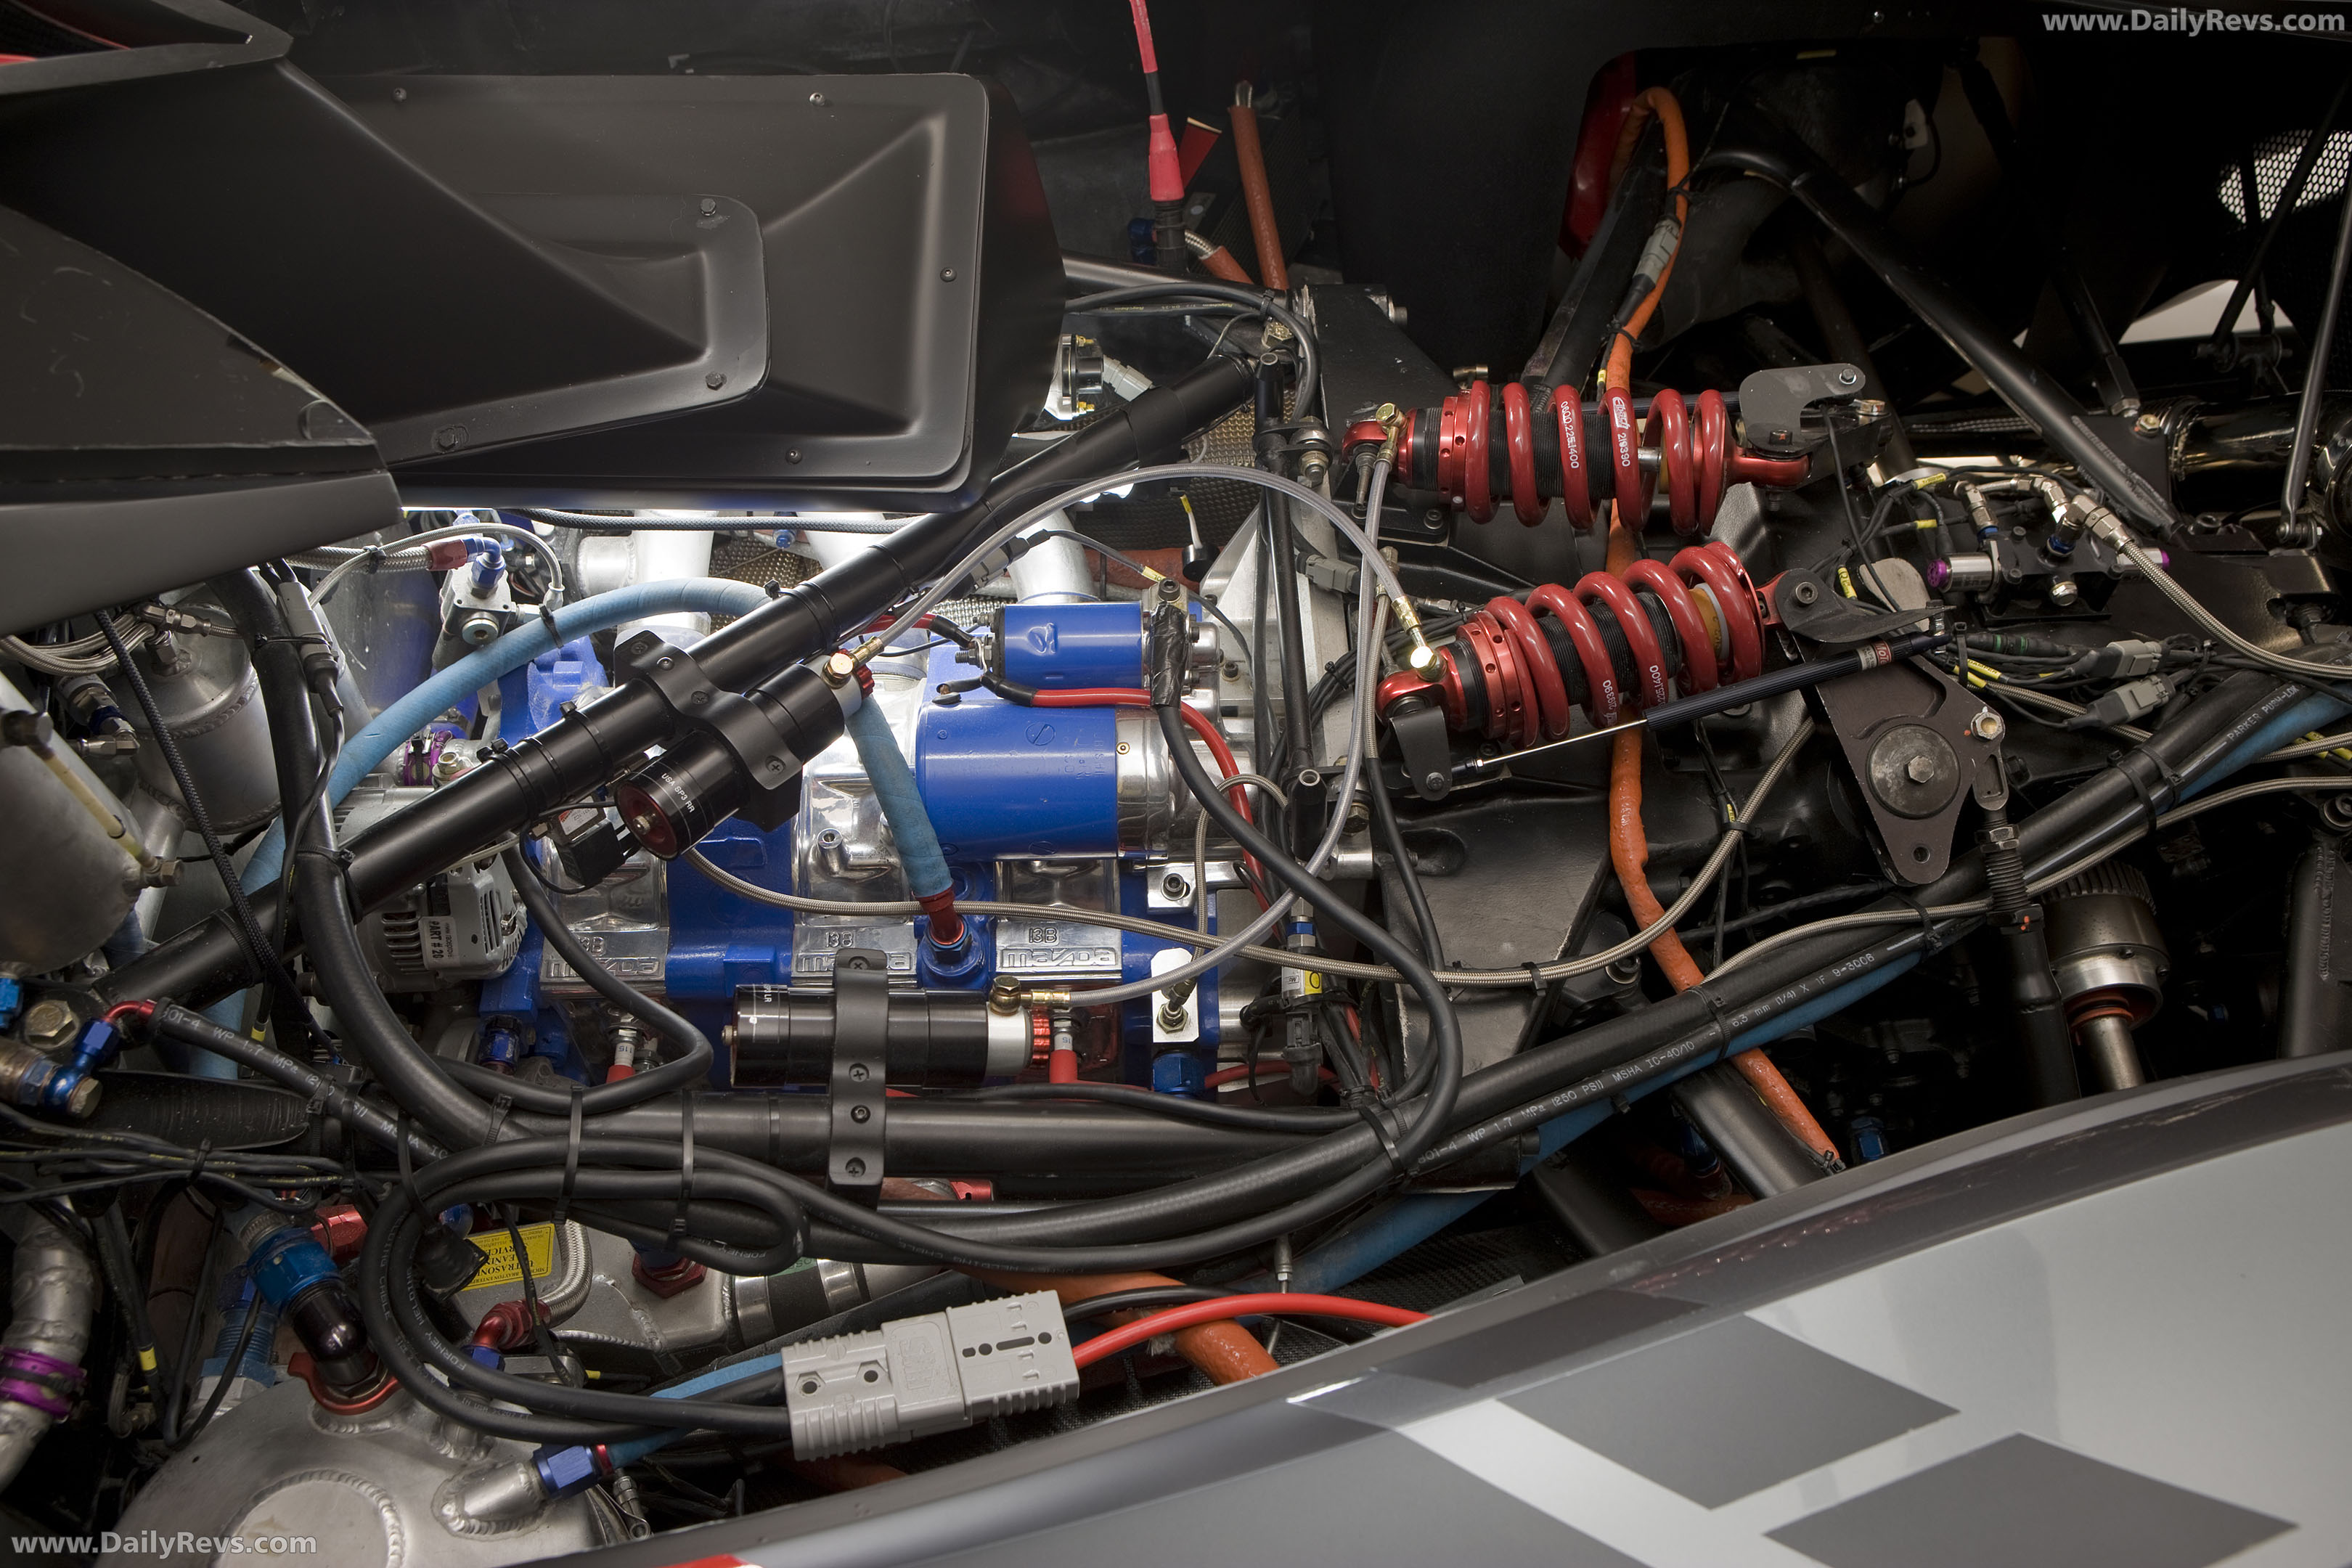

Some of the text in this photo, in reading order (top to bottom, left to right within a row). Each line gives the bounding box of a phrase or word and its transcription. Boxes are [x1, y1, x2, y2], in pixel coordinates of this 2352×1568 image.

[2226, 712, 2263, 742] PARKER
[661, 773, 695, 813] USA SP3 RR
[429, 921, 442, 941] PART
[578, 936, 605, 955] 3B
[826, 931, 853, 947] 13B
[1029, 928, 1058, 943] 13B
[213, 1026, 235, 1040] WP
[243, 1040, 264, 1055] 1.7
[1467, 1128, 1486, 1143] WP
[1495, 1117, 1513, 1132] 1.7
[1552, 1090, 1577, 1107] (250
[1612, 1065, 1643, 1082] MSHA
[1645, 1041, 1695, 1068] IC-40/10
[1755, 1004, 1771, 1016] mm
[1776, 989, 1797, 1005] (1/4)
[1799, 984, 1810, 993] X
[425, 1331, 468, 1371] FORNEY
